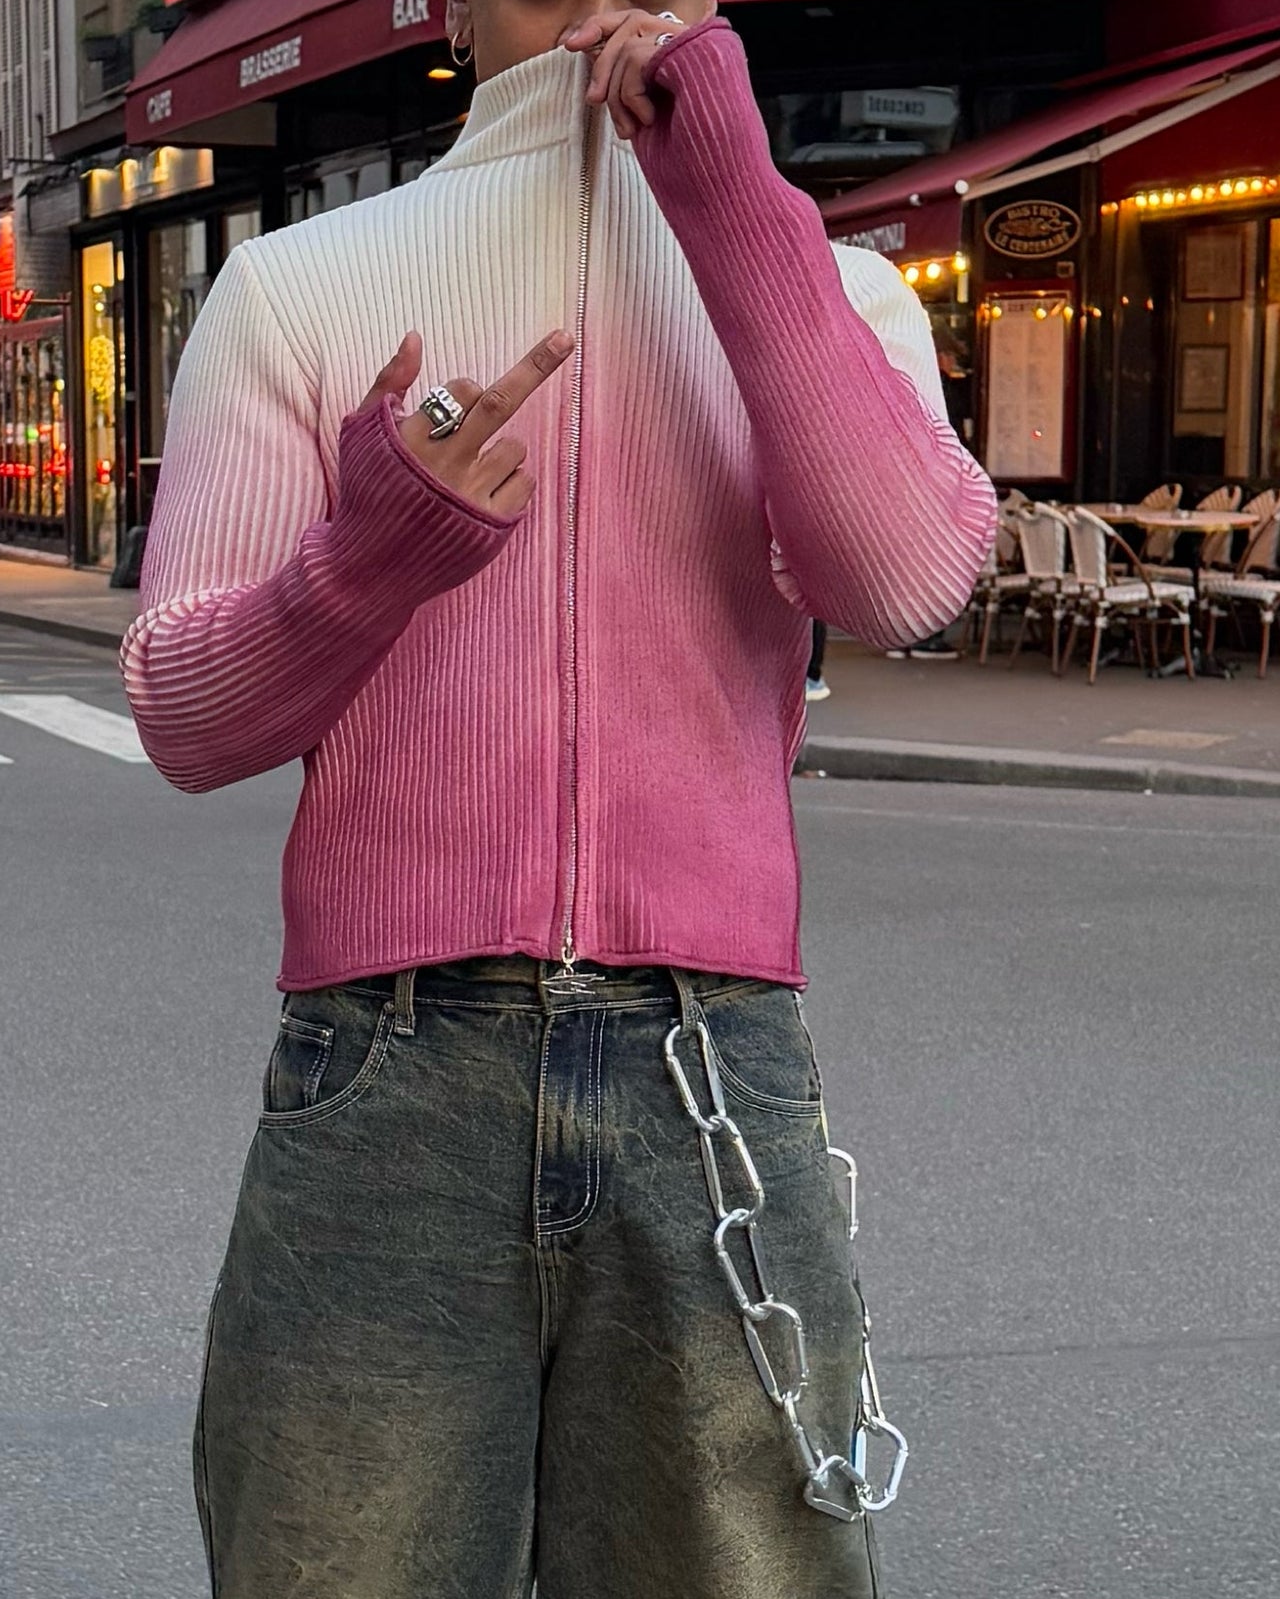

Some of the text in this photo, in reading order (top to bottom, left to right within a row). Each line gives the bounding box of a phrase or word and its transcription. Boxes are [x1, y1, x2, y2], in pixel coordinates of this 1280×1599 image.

[240, 35, 302, 88] BRASSERIE
[1007, 205, 1060, 220] BISTRO
[994, 232, 1006, 248] LE
